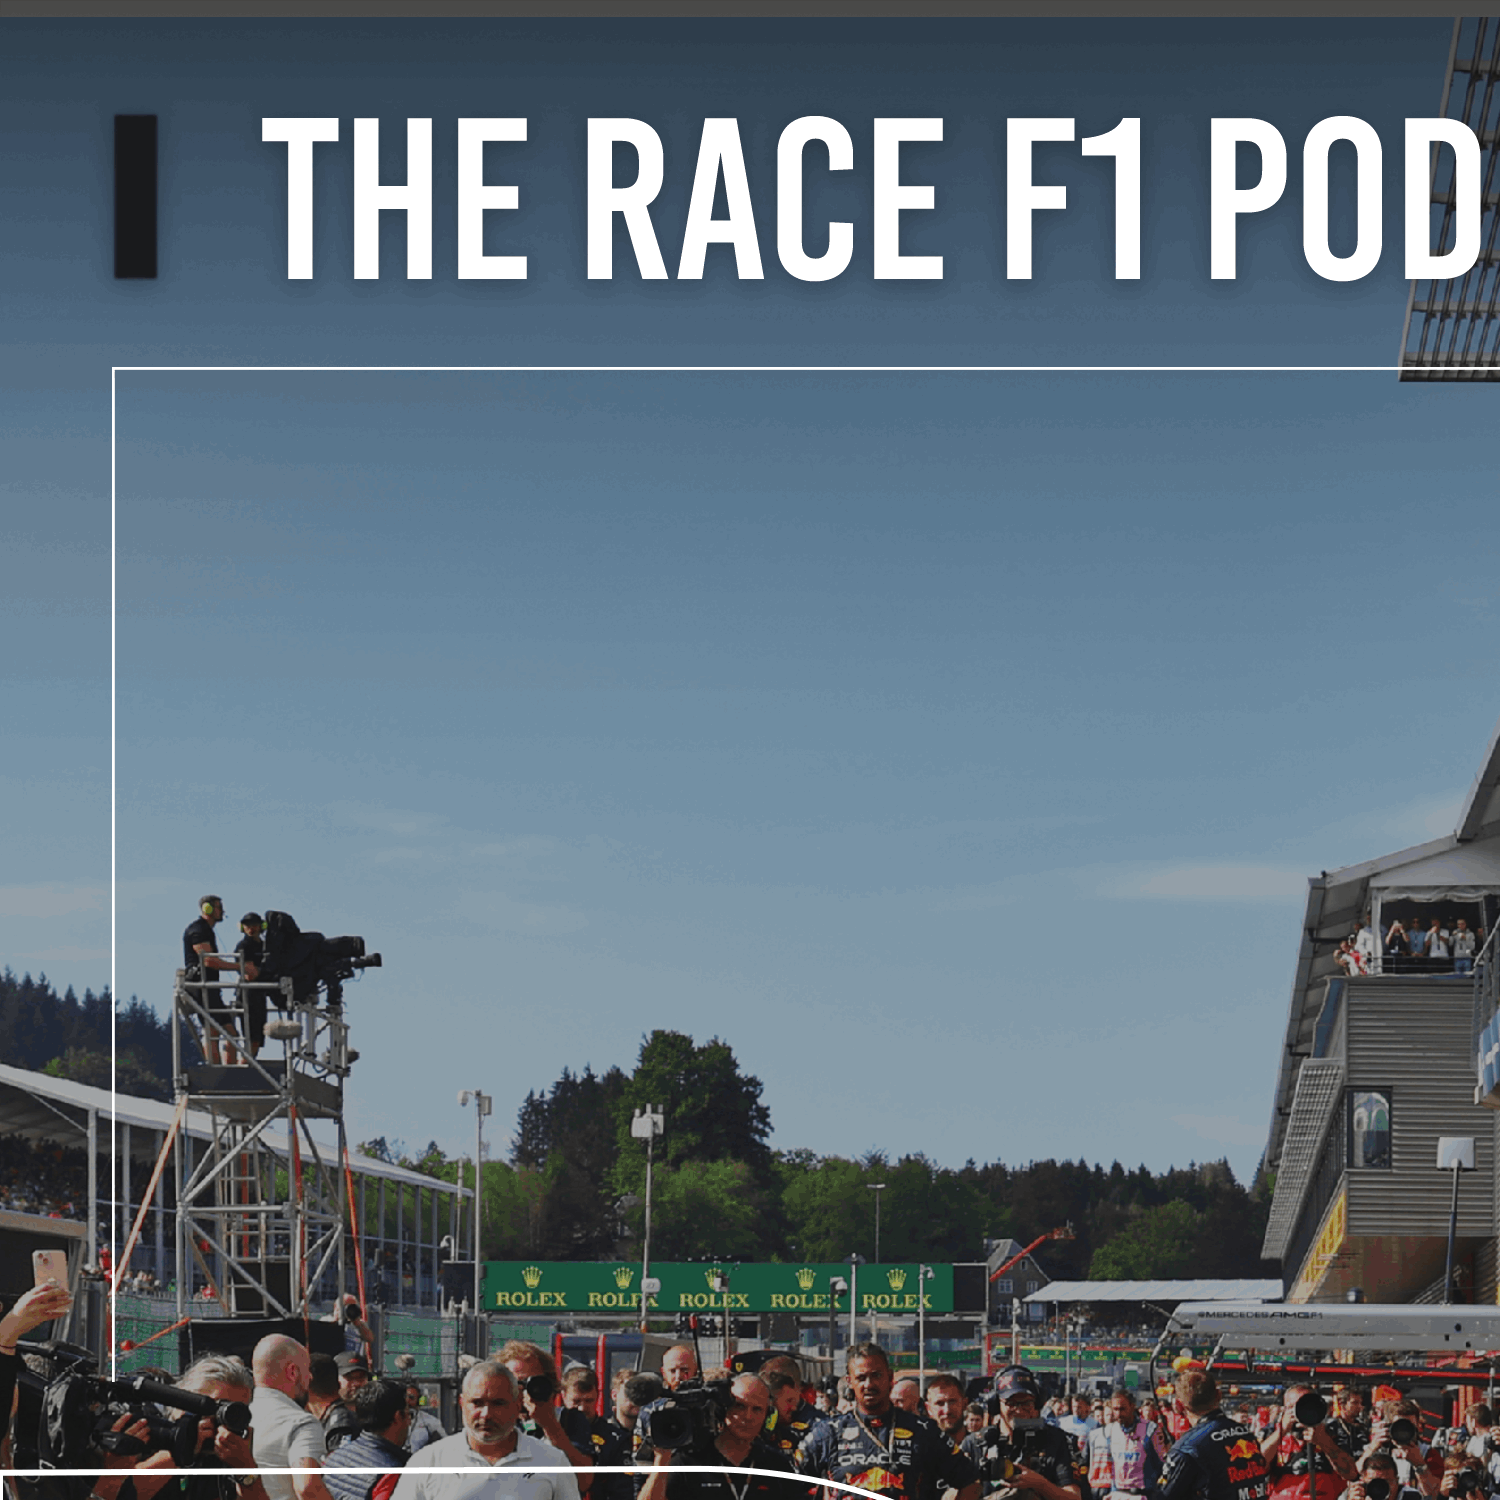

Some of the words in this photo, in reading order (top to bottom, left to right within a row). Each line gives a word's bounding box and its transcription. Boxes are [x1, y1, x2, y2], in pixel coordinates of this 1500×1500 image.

[496, 1291, 568, 1307] ROLEX
[679, 1292, 750, 1308] ROLEX
[861, 1292, 932, 1308] ROLEX
[838, 1453, 911, 1466] ORACLE
